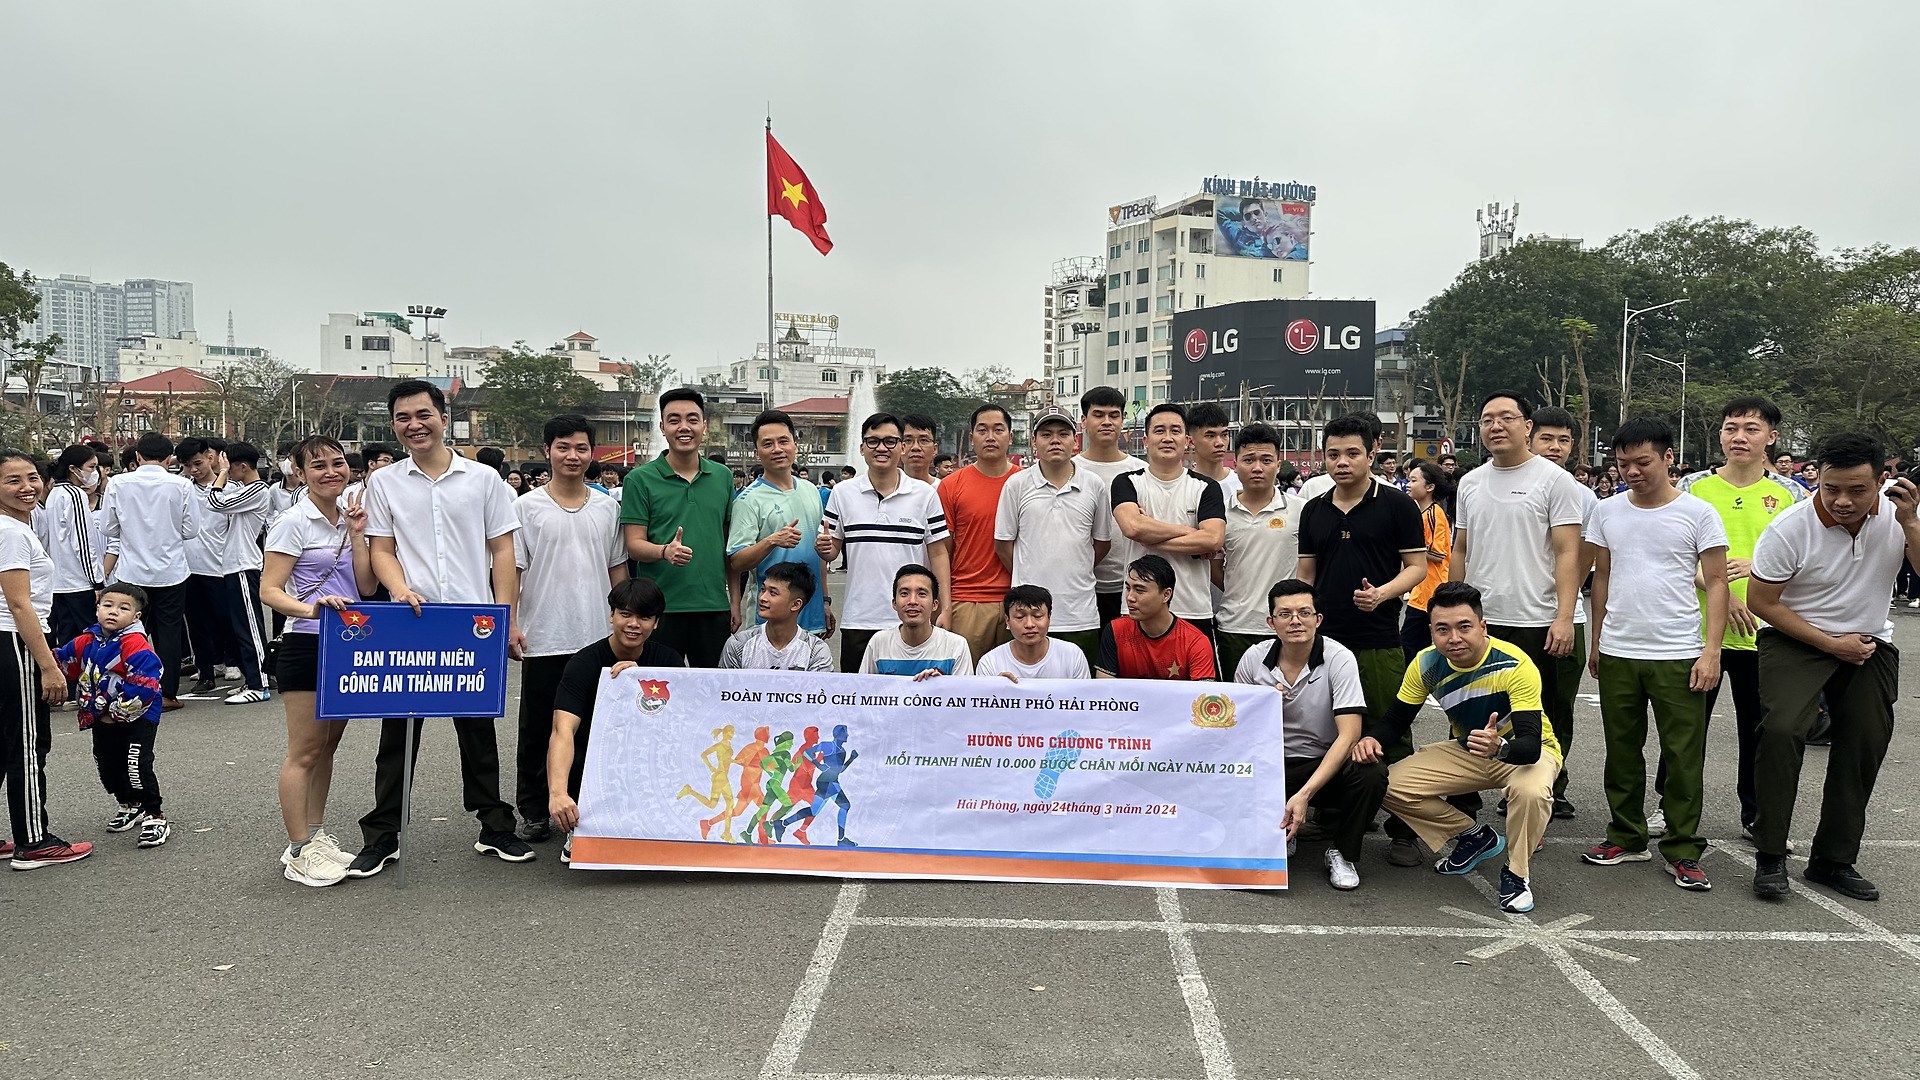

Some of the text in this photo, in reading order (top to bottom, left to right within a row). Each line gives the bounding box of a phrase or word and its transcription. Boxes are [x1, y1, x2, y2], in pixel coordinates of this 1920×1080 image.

[1203, 175, 1235, 195] KÍNH
[1240, 175, 1268, 198] MẮT
[1121, 200, 1156, 220] TPBank
[1211, 328, 1239, 355] LG
[1323, 325, 1361, 350] LG
[1304, 368, 1341, 376] www.lg.com
[353, 648, 475, 667] BAN THANH NIÊN
[339, 668, 487, 693] CÔNG AN THÀNH PHỐ
[720, 688, 1139, 712] ĐOÀN TNCS HỒ CHÍ MINH CÔNG AN THÀNH PHỐ HẢI PHÒNG
[967, 731, 1012, 747] HƯỞNG
[1017, 733, 1044, 748] ỨNG
[1108, 736, 1151, 750] TRÌNH
[127, 743, 144, 790] LOVEMOON
[885, 751, 910, 766] MỖI
[914, 756, 958, 767] THANH
[961, 755, 992, 768] NIÊN
[996, 758, 1036, 769] 10.000
[1039, 757, 1076, 770] BƯỚC
[1079, 758, 1115, 771] CHÂN
[1118, 756, 1144, 772] MỖI
[1147, 759, 1183, 773] NGÀY
[1185, 761, 1215, 774] NĂM
[957, 799, 977, 810] Hải
[980, 799, 1020, 813] Phòng,
[1104, 804, 1112, 815] 3
[1115, 804, 1142, 814] năm
